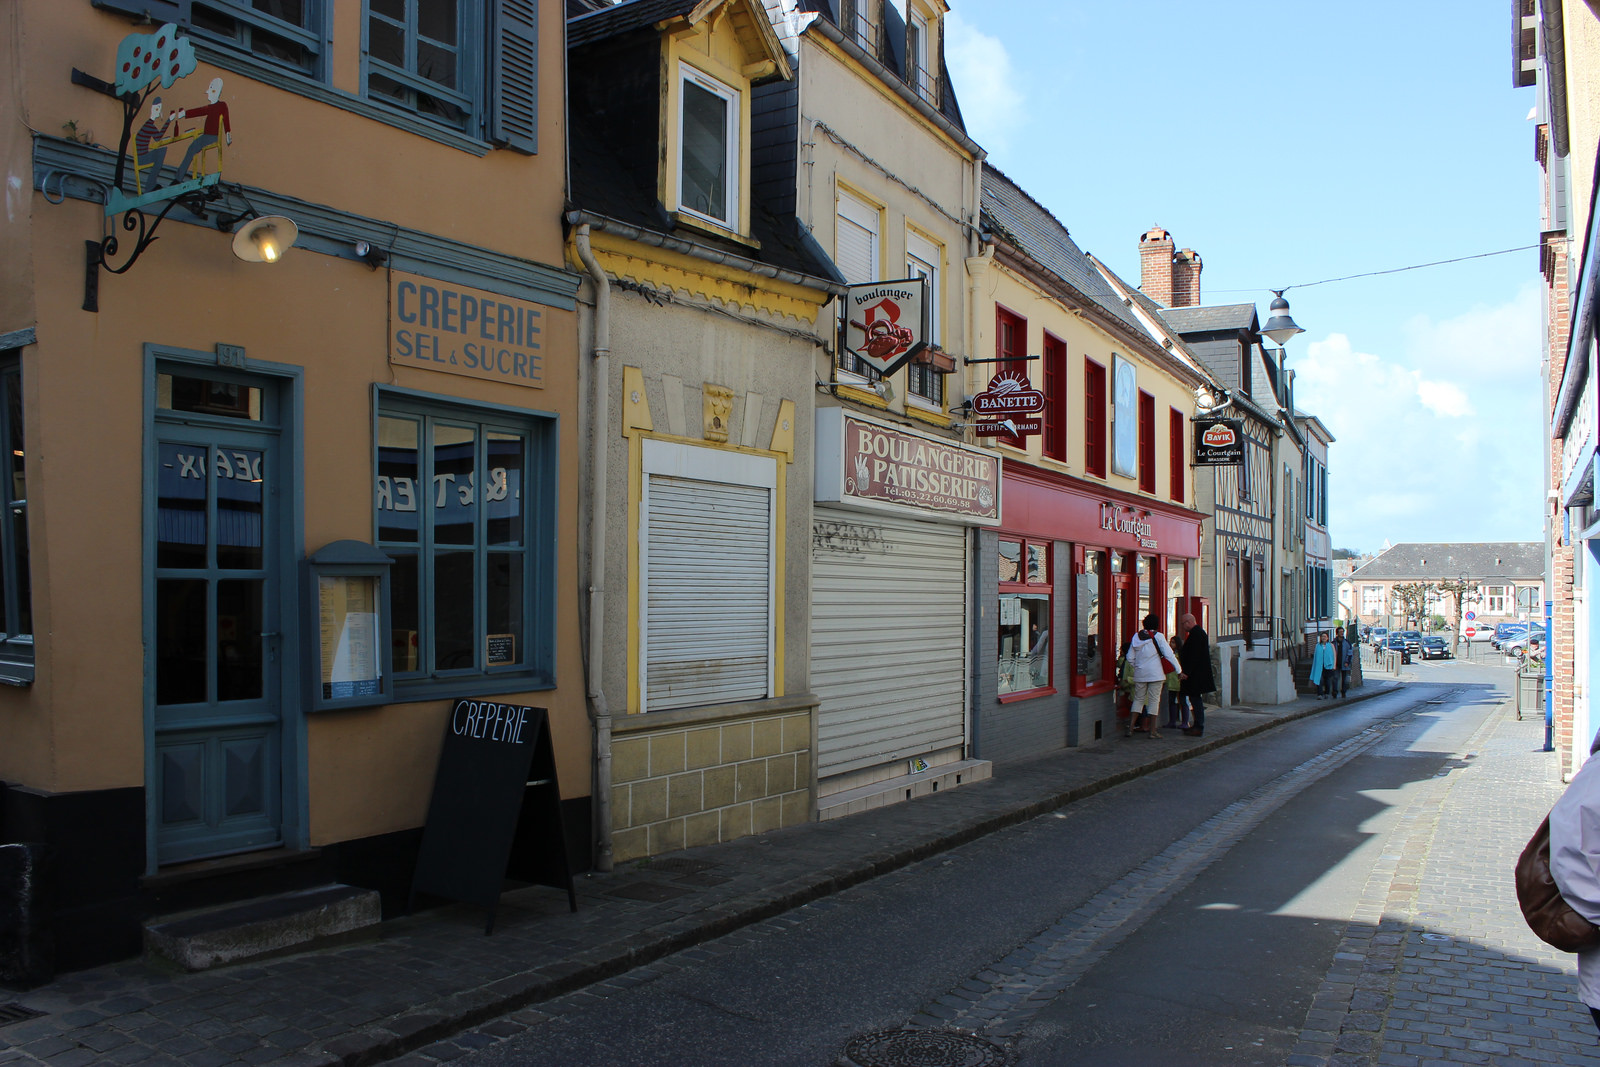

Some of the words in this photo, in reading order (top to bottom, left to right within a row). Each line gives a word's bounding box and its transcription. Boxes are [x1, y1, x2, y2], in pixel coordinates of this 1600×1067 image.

[397, 281, 541, 349] CREPERIE
[855, 288, 913, 305] boulanger
[396, 329, 446, 363] SEL
[449, 350, 458, 366] &
[463, 343, 542, 380] SUCRE
[980, 396, 1038, 409] BANETTE
[858, 429, 990, 481] BOULANGERIE
[1197, 449, 1206, 457] Le
[1207, 449, 1241, 457] Courtgain
[1206, 433, 1231, 441] BAVIK
[873, 458, 979, 501] PATISSERIE
[1101, 503, 1113, 530] Le
[1114, 506, 1151, 542] Courtgain
[453, 700, 532, 744] CREPERIE
